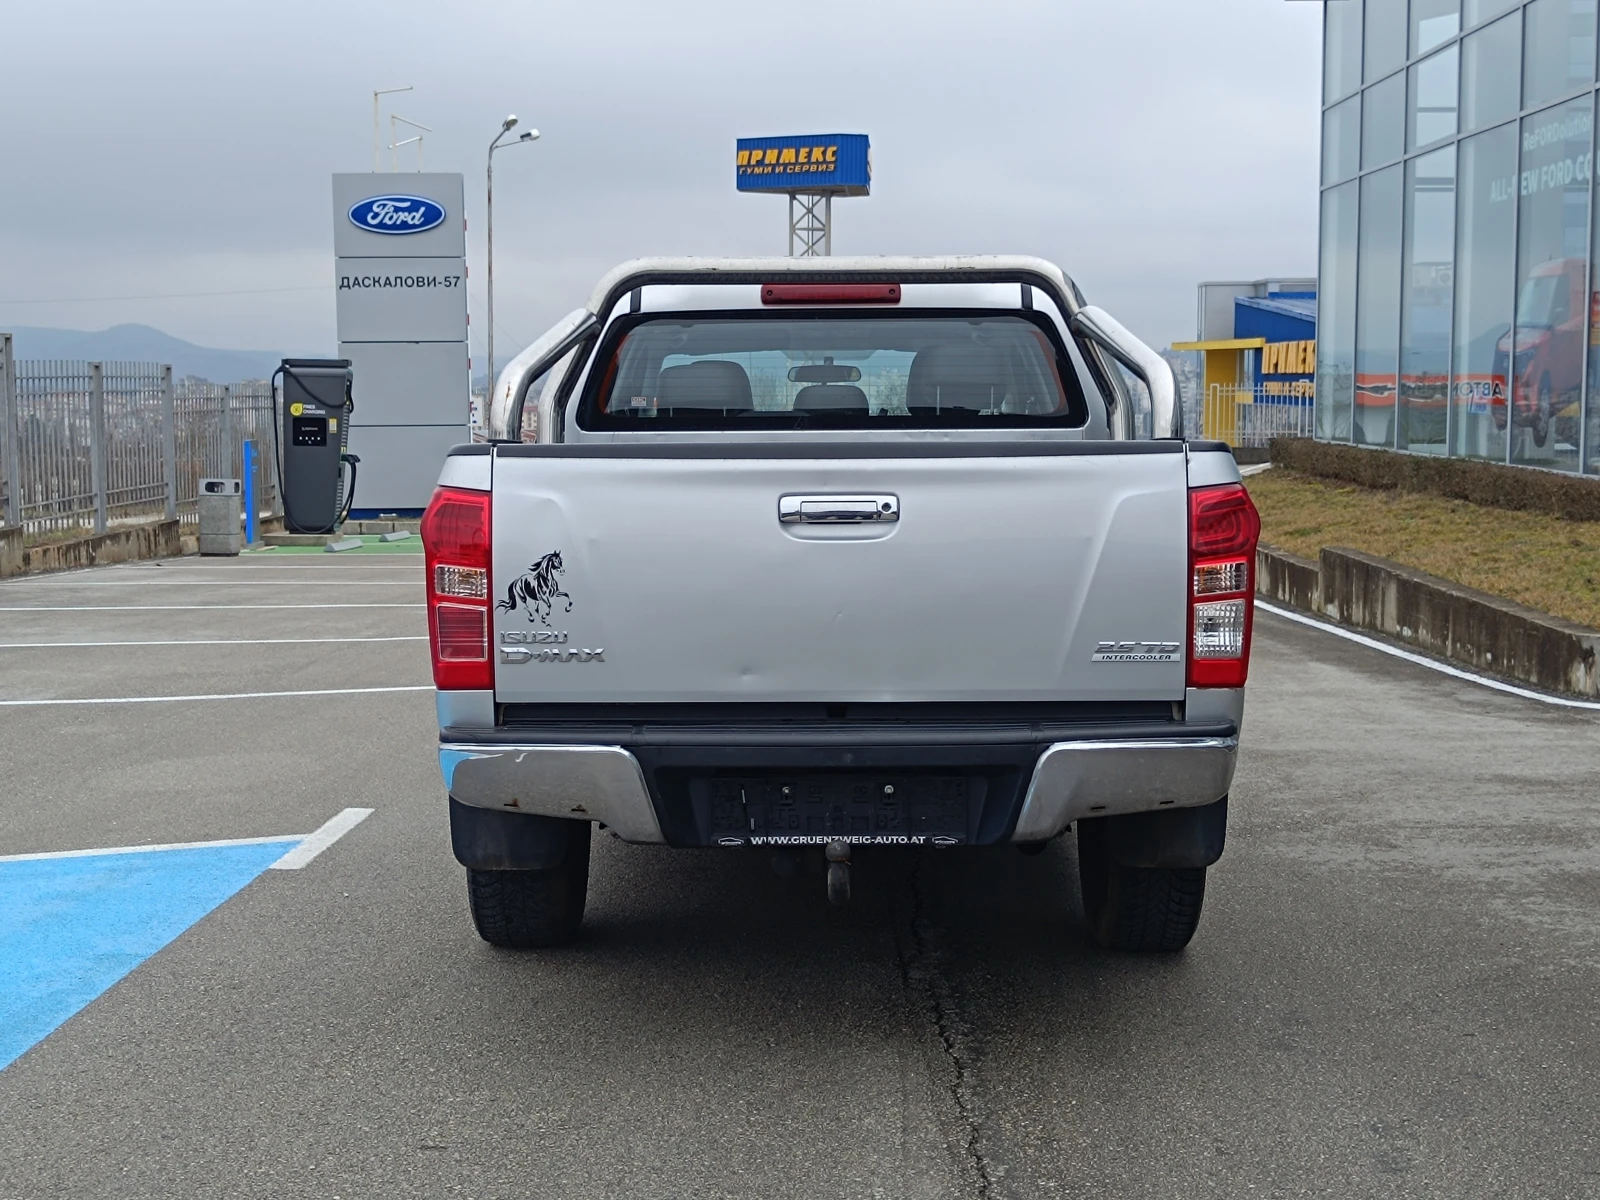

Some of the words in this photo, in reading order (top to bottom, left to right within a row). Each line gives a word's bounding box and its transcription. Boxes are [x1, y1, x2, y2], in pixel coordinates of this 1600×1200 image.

[737, 147, 838, 165] ПРИМЕКС
[739, 166, 772, 175] ГУМИ
[775, 165, 783, 174] И
[786, 163, 835, 174] СЕРВИЗ
[1540, 159, 1573, 190] FORD
[367, 200, 426, 225] Ford
[339, 276, 460, 290] ДАСКАЛОВИ-57
[500, 630, 568, 644] ISUZU
[500, 646, 606, 664] D-MAX
[750, 835, 926, 845] WWW.GRUENZWEIG-AUTO.AT
